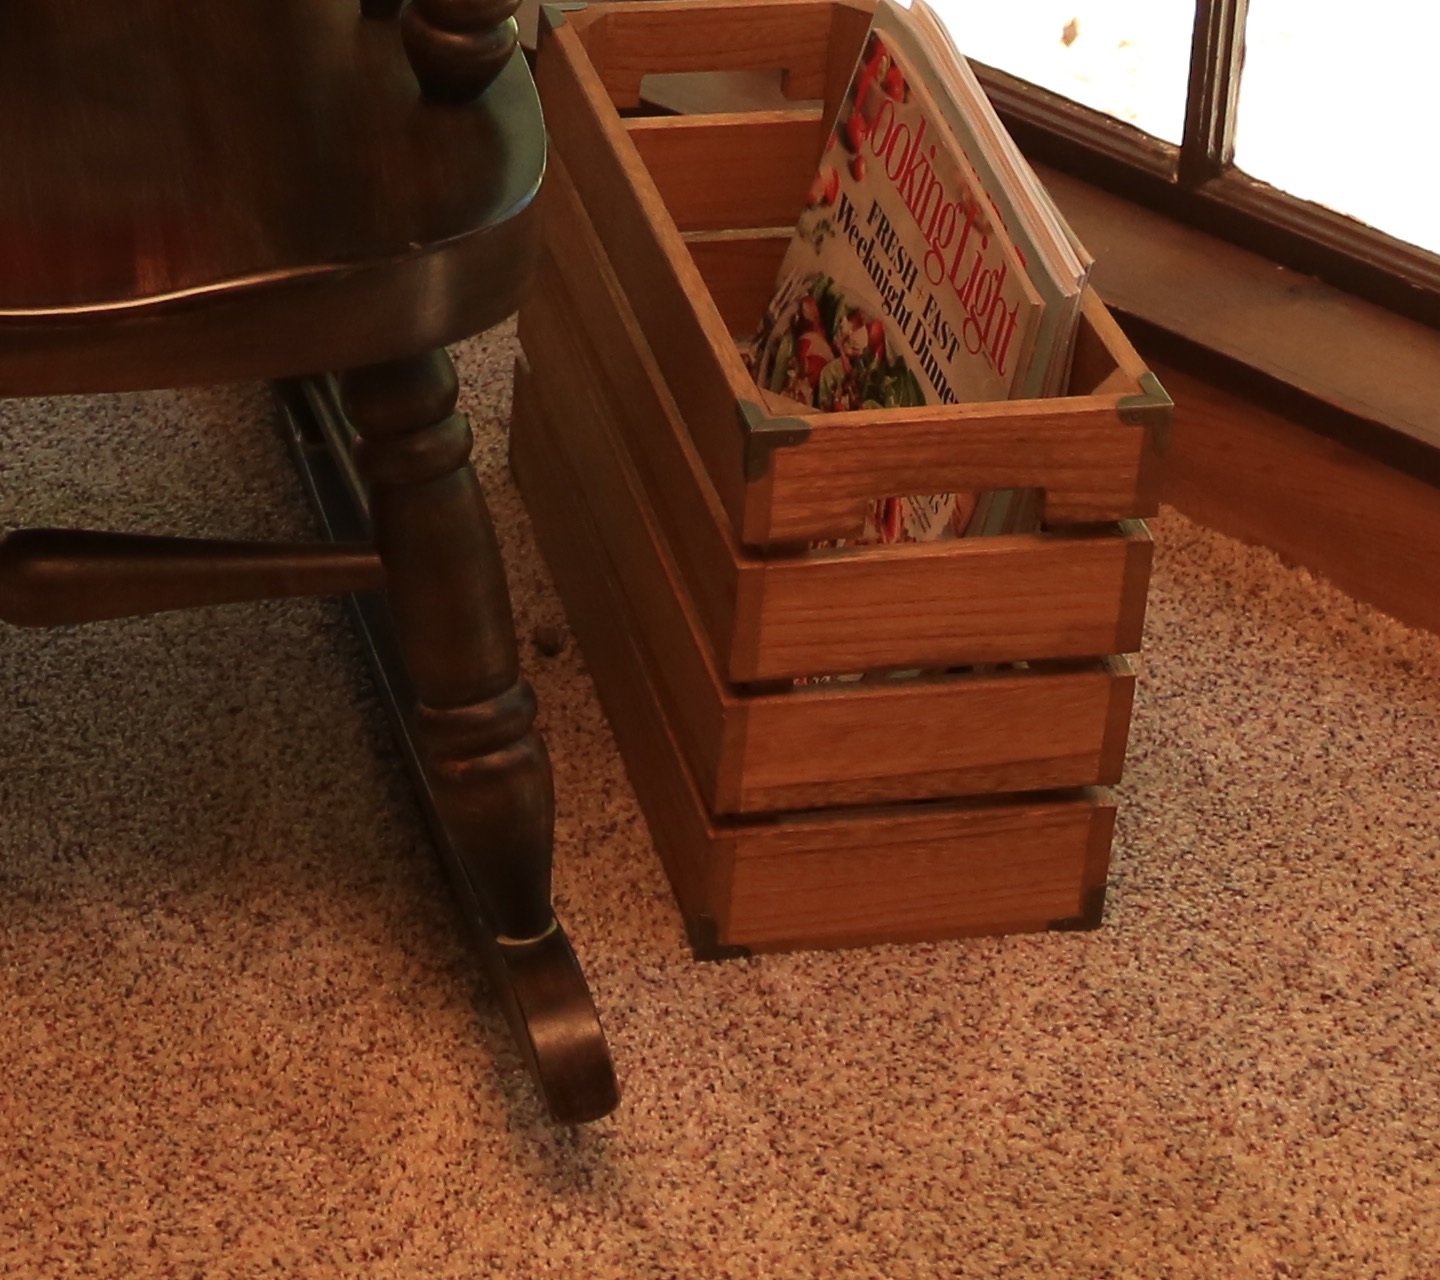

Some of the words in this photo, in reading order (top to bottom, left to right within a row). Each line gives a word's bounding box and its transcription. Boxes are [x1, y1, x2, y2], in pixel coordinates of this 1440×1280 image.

[834, 191, 914, 336] Weeknight
[908, 318, 960, 405] Dinne
[866, 199, 919, 294] FRESH
[922, 293, 961, 364] FAST
[947, 202, 1020, 376] Light
